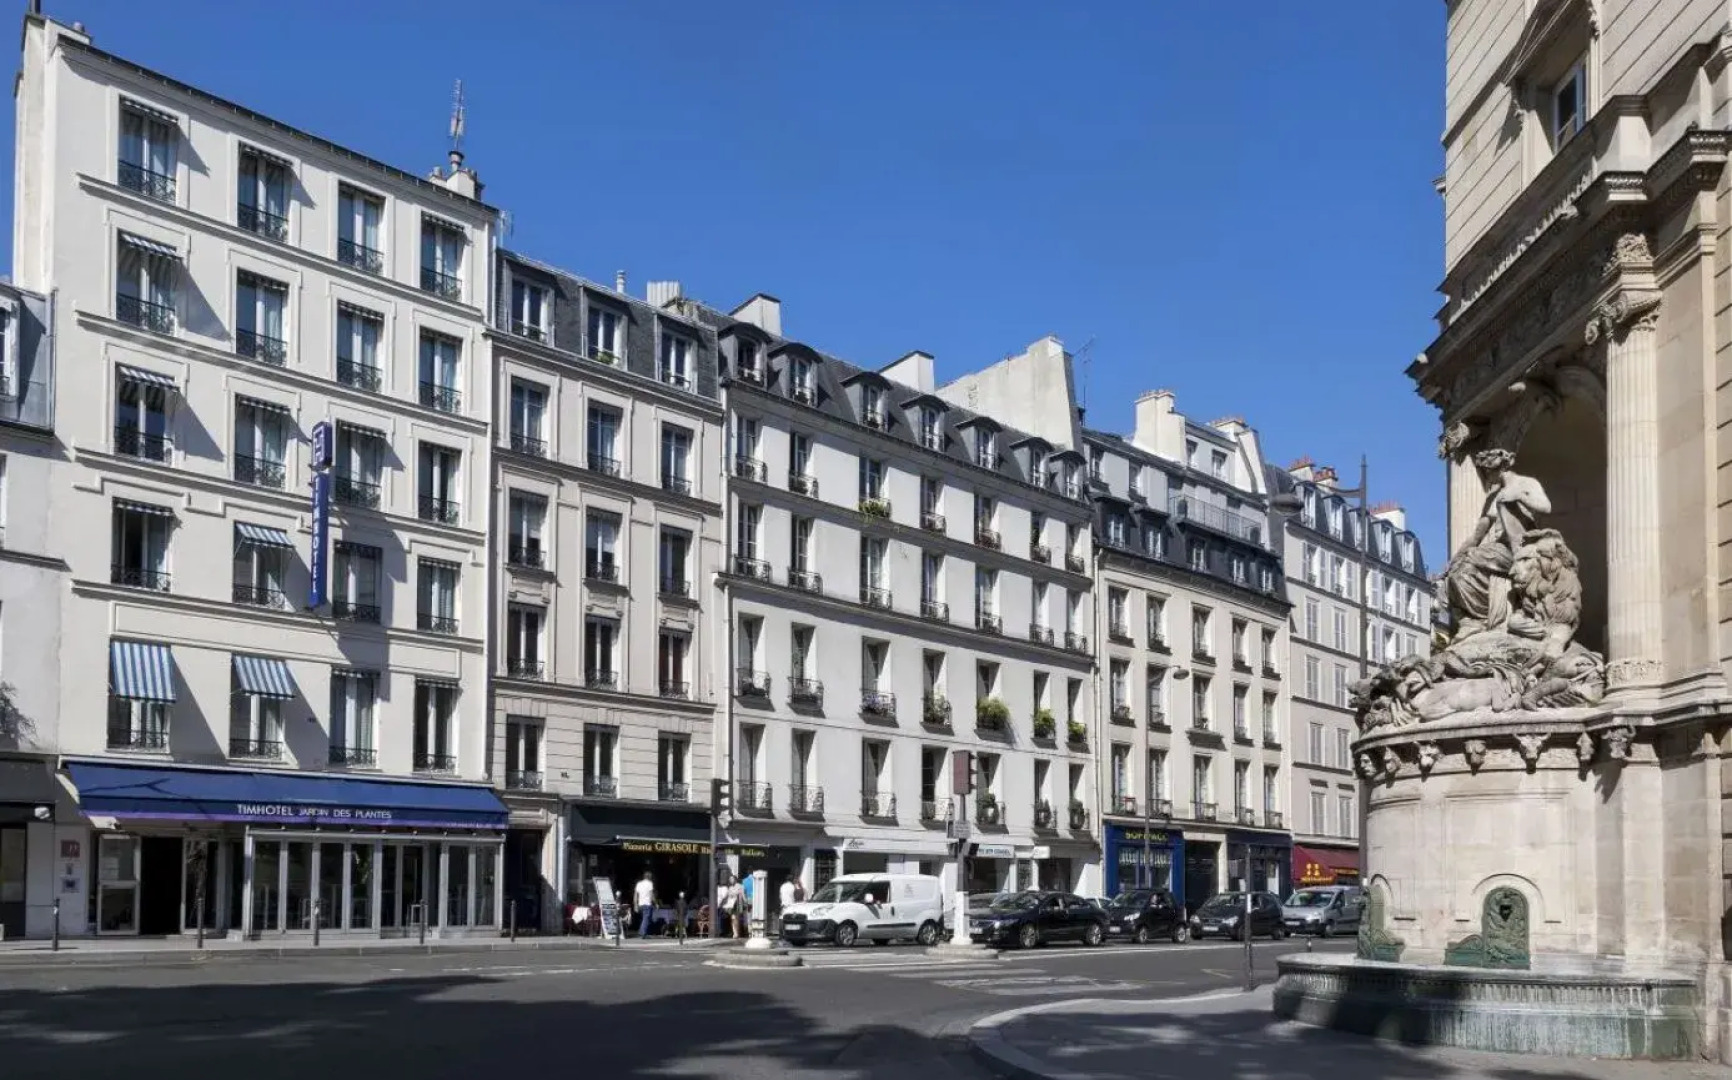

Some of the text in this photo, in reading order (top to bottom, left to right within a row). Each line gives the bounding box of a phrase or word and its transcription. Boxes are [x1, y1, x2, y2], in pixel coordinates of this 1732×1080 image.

[312, 477, 320, 593] TIMHOTEL
[237, 804, 392, 819] TIMHOTEL JARDIN DES PLANTES
[655, 842, 698, 854] GIRASOLE
